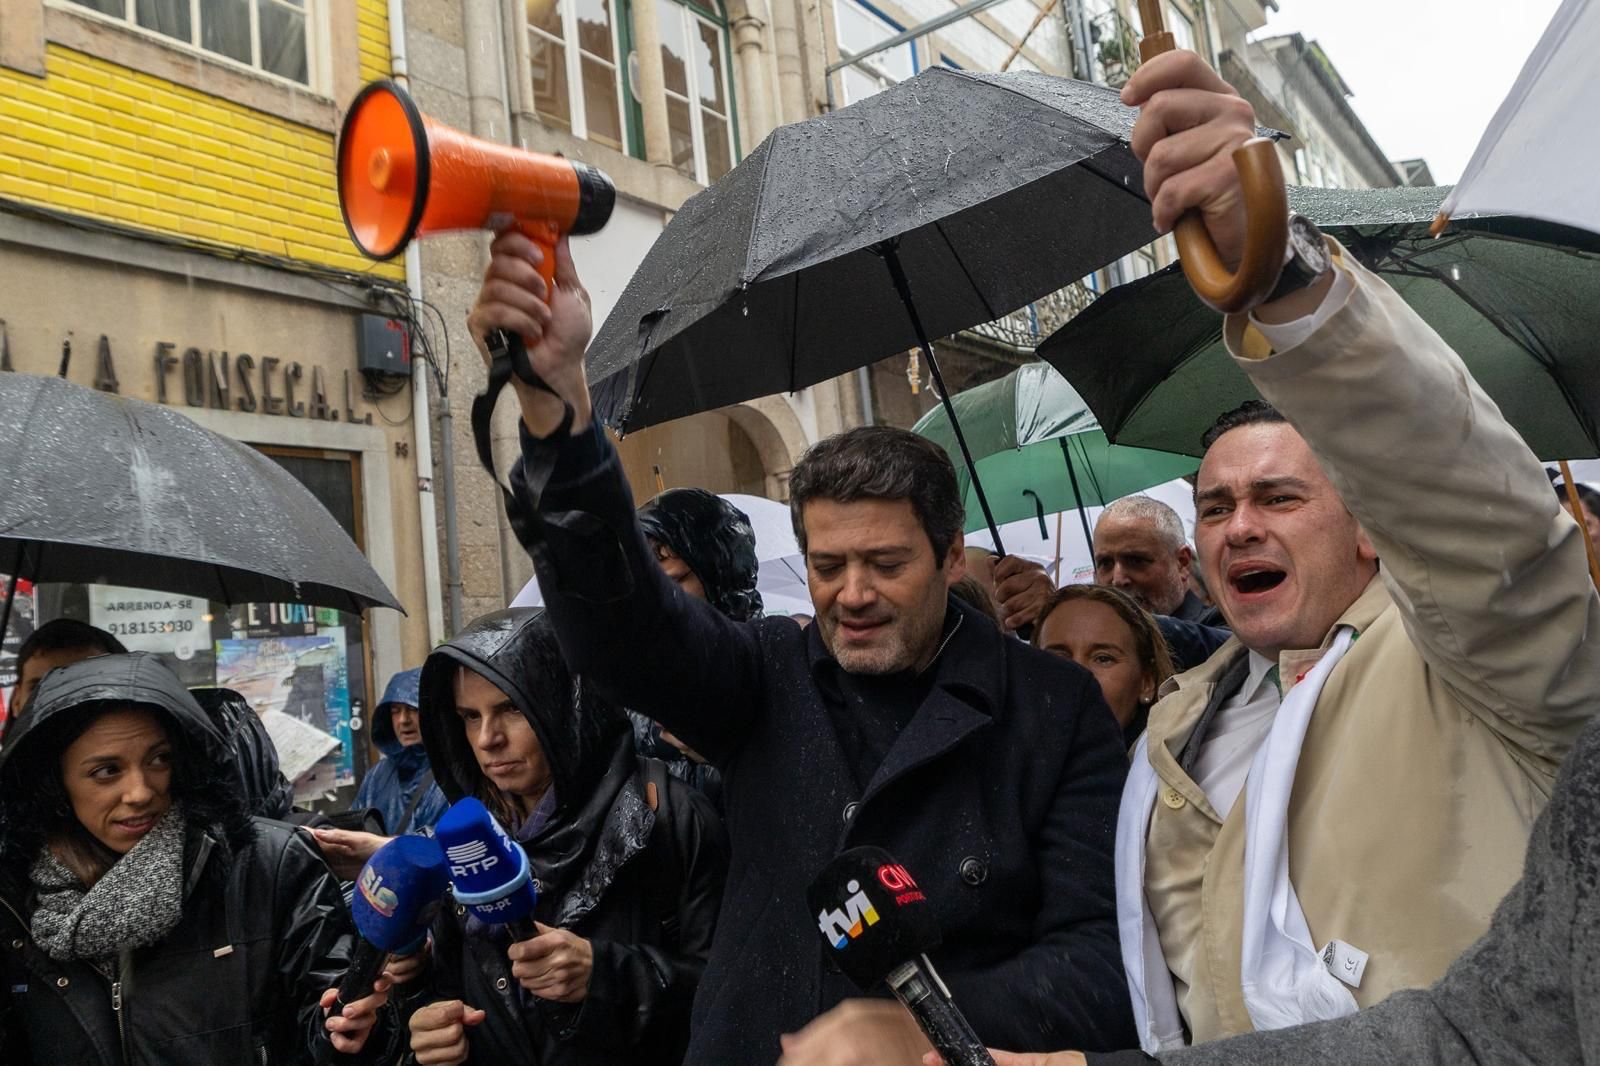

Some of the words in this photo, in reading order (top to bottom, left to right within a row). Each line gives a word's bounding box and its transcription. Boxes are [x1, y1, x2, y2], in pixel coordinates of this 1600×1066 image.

[106, 600, 193, 612] ARRENDA-SE
[450, 855, 499, 877] RTP
[818, 879, 881, 950] tvi
